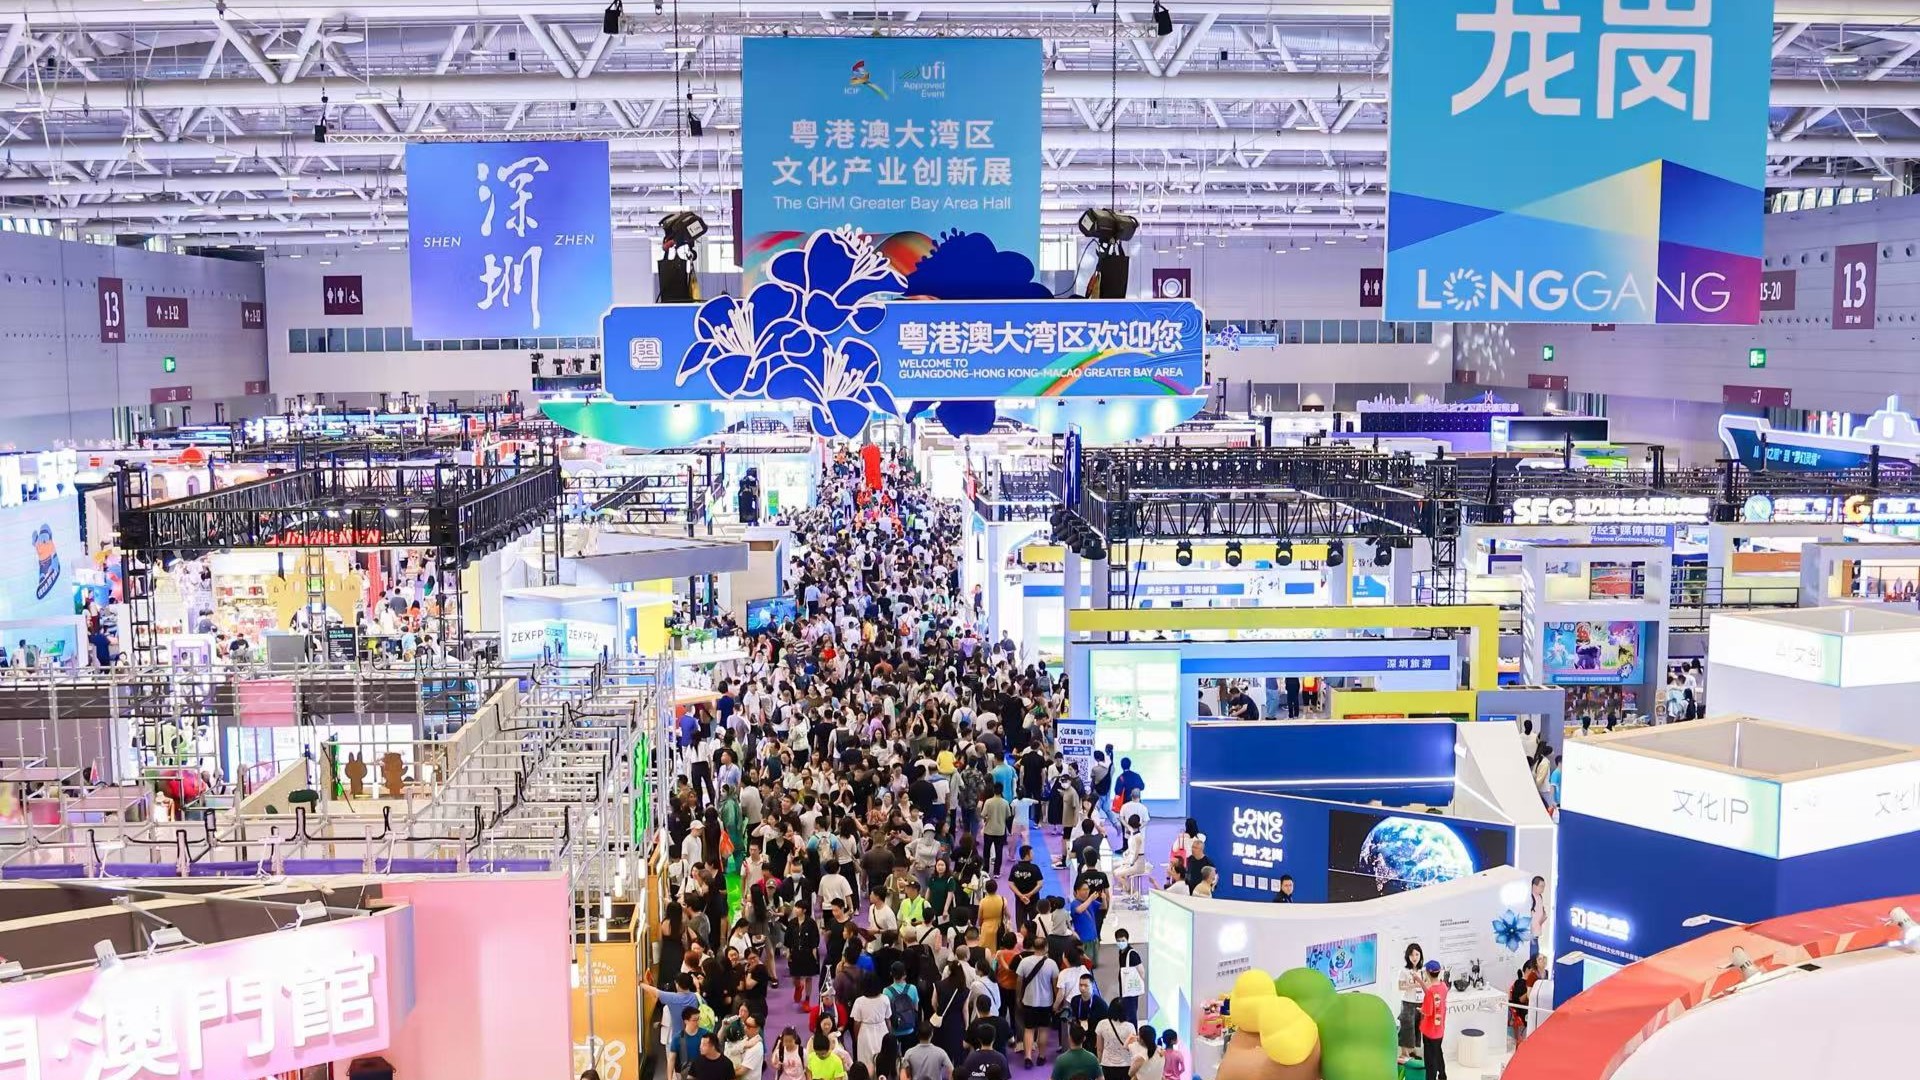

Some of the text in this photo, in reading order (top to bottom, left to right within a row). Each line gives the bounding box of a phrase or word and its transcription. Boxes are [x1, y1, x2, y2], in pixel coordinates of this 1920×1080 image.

[922, 62, 945, 79] ufi
[1452, 0, 1711, 121] 龙岗
[903, 82, 944, 91] Approved
[921, 90, 944, 98] Event
[790, 119, 994, 149] 粤港澳大湾区
[772, 156, 1012, 186] 文化产业创新展
[774, 196, 1011, 212] The GHM Greater Bay Area Hall
[424, 237, 461, 248] SHEN
[477, 157, 549, 329] 深圳
[554, 235, 594, 246] ZHEN
[1842, 261, 1867, 308] 13
[104, 291, 120, 327] 13
[898, 320, 1183, 355] 粤港澳大湾区欢迎您
[899, 358, 969, 369] WELCOME TO
[1084, 367, 1131, 378] GREATER
[1133, 367, 1153, 378] BAY
[1154, 366, 1184, 377] AREA
[1513, 497, 1574, 525] SFC
[1387, 658, 1432, 669] 深圳旅游
[1234, 806, 1283, 828] LONG
[1672, 789, 1749, 824] 文化IP
[1232, 822, 1283, 843] GANG
